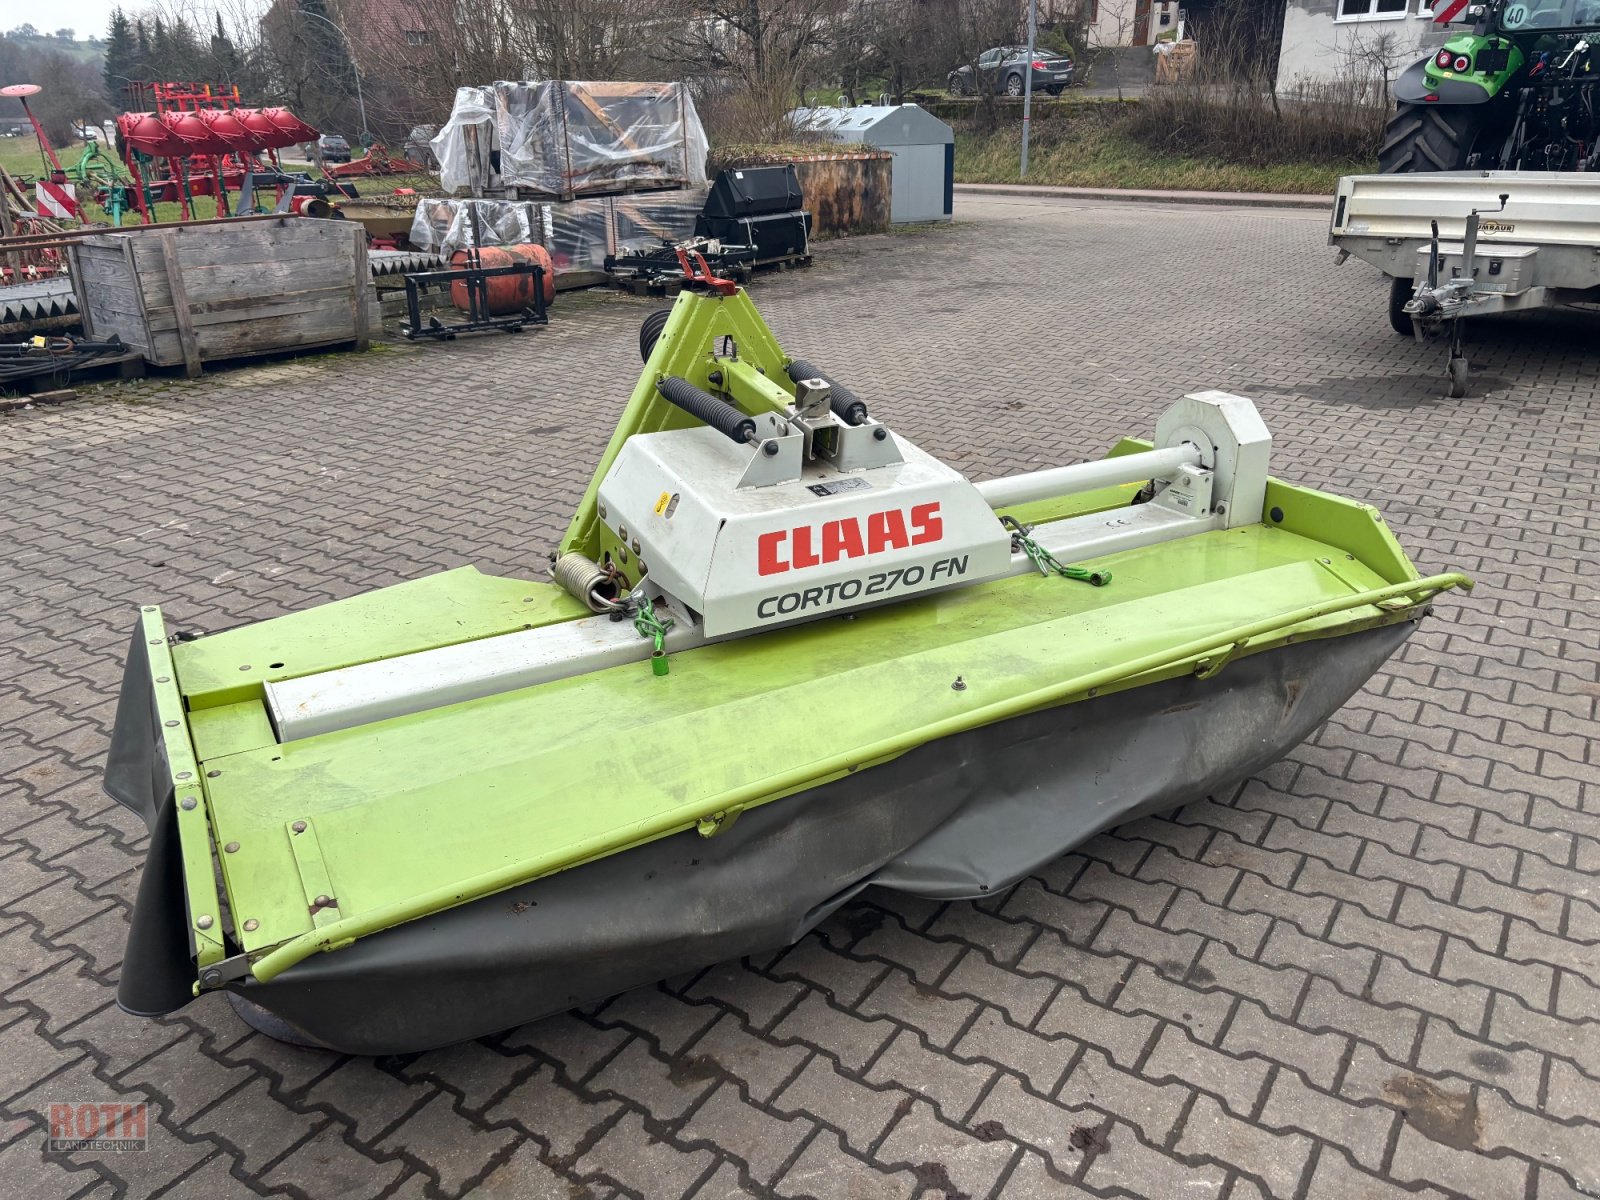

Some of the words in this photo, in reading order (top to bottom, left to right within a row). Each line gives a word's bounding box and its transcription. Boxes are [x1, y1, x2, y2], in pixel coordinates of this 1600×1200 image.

[1507, 8, 1524, 24] 40
[758, 502, 942, 576] CLAAS
[757, 578, 862, 619] CORTO
[864, 565, 925, 596] 270
[929, 555, 968, 581] FN
